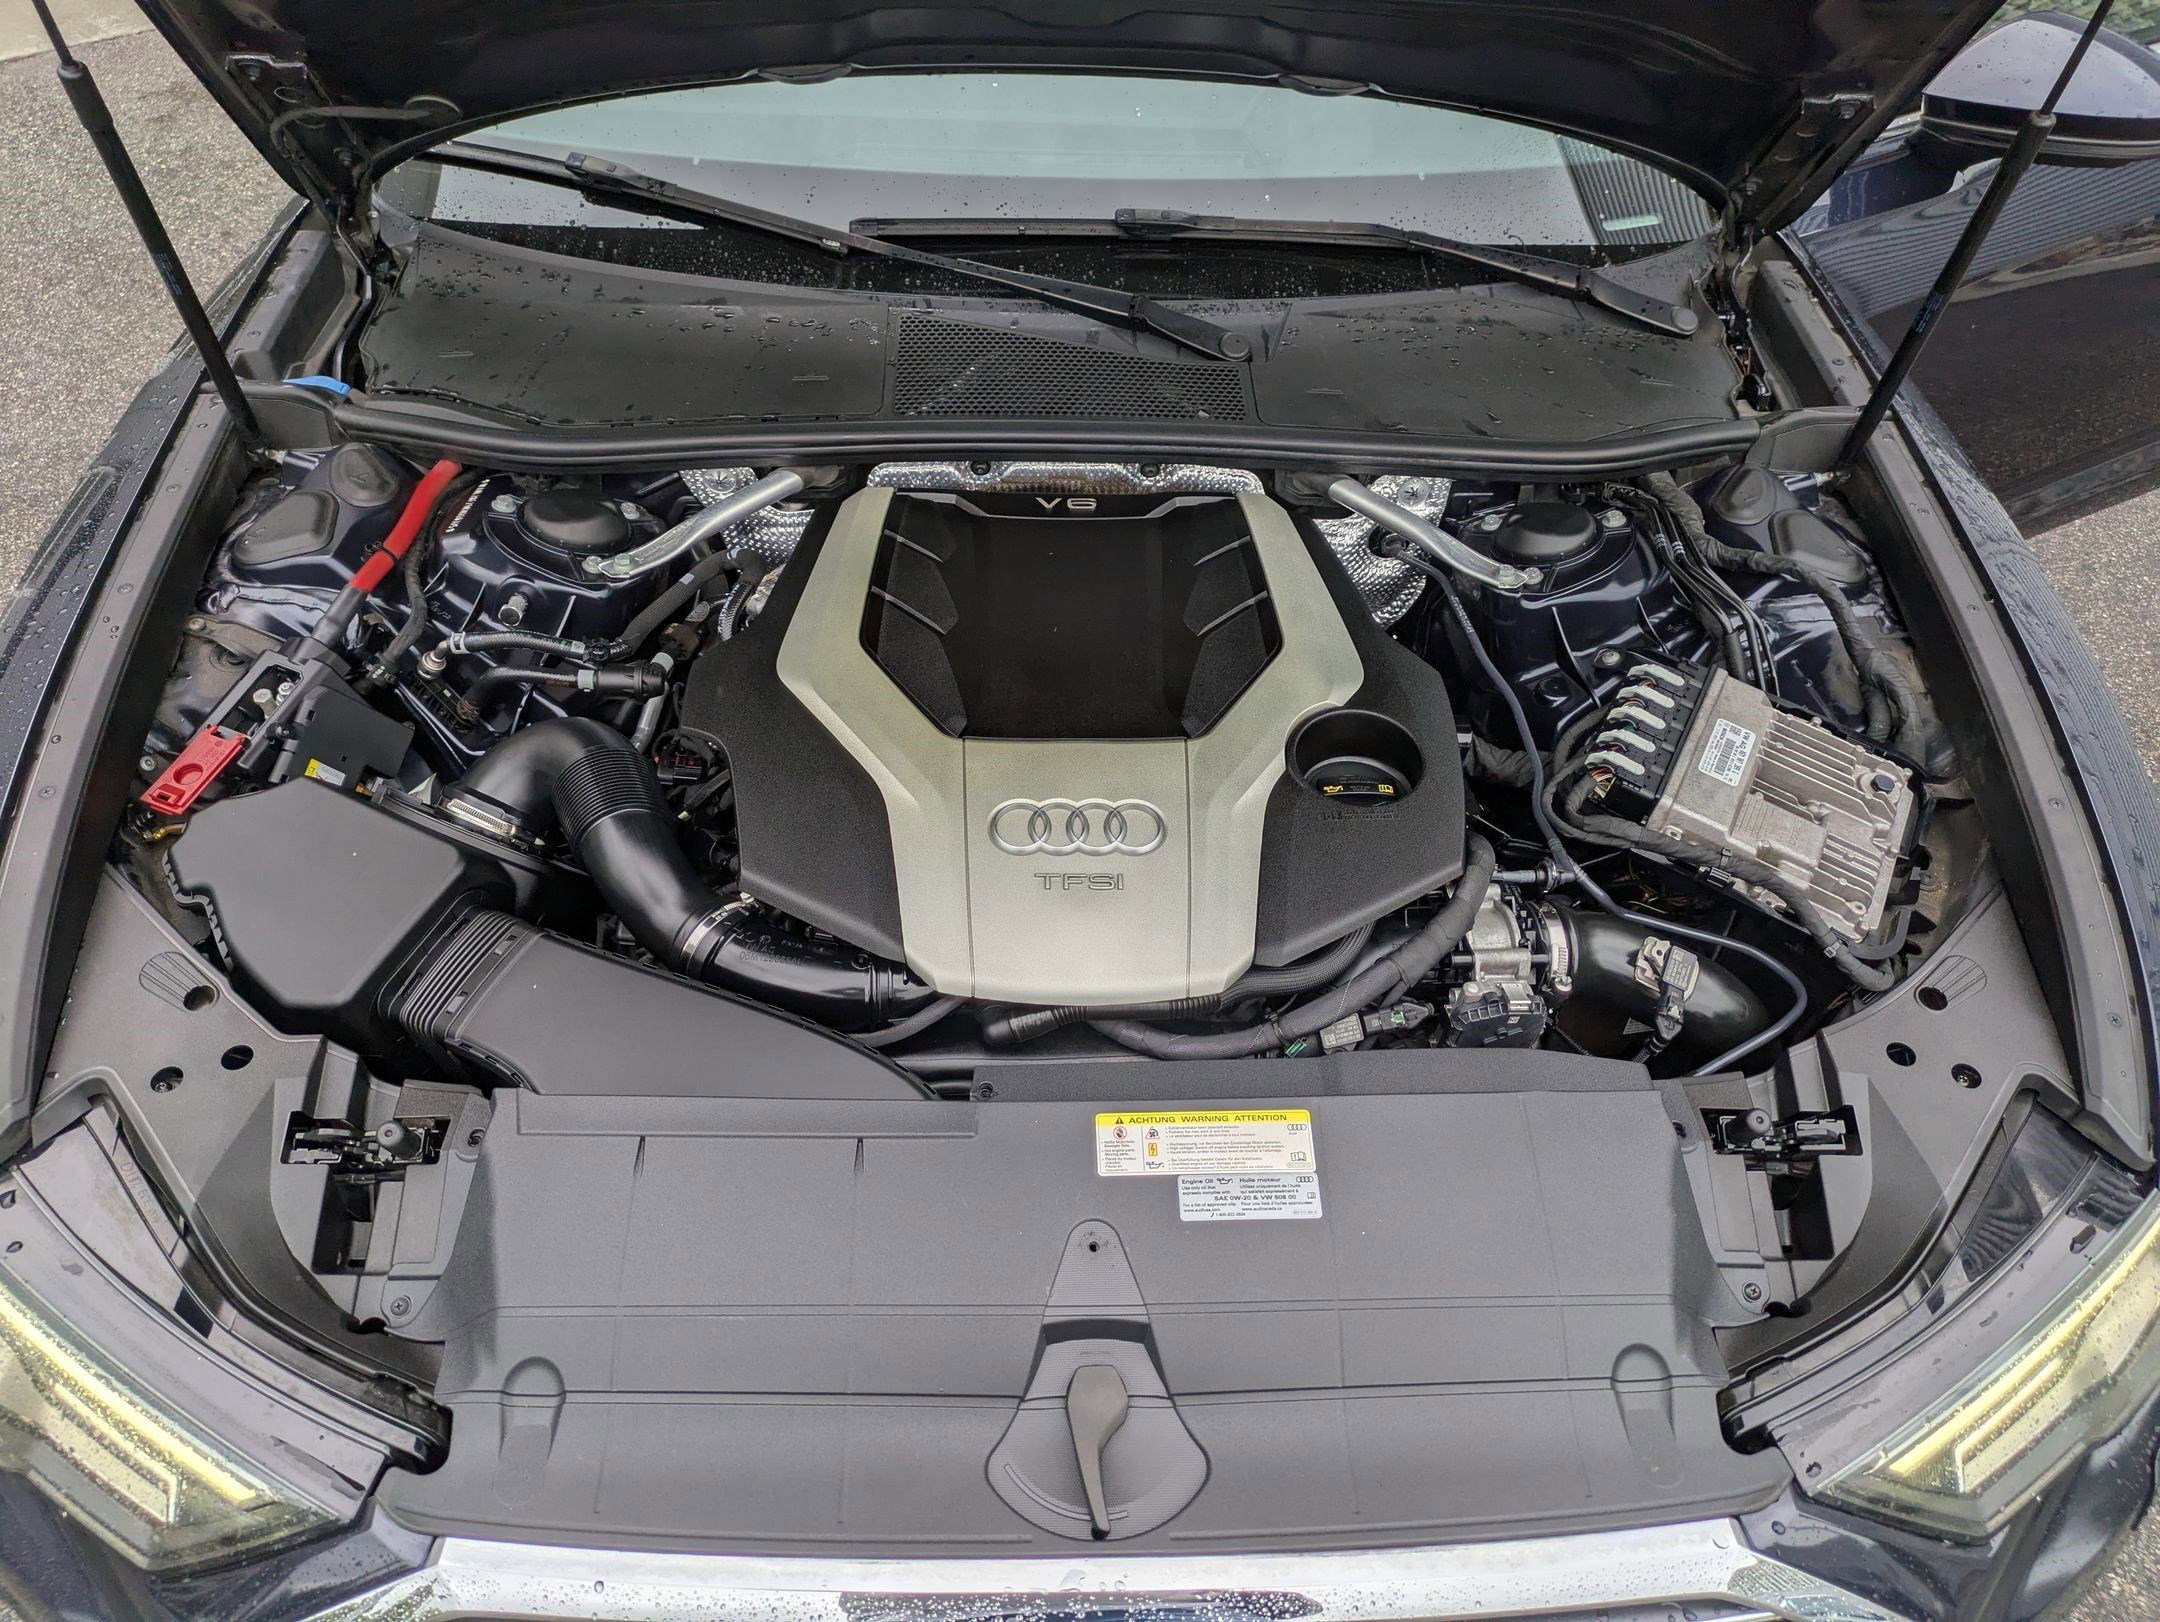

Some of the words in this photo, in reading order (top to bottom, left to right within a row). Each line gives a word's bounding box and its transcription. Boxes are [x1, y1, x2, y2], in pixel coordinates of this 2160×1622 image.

[1035, 497, 1097, 509] V6
[1742, 731, 1752, 741] VW
[1740, 740, 1748, 750] AG
[1034, 872, 1124, 890] TFSI
